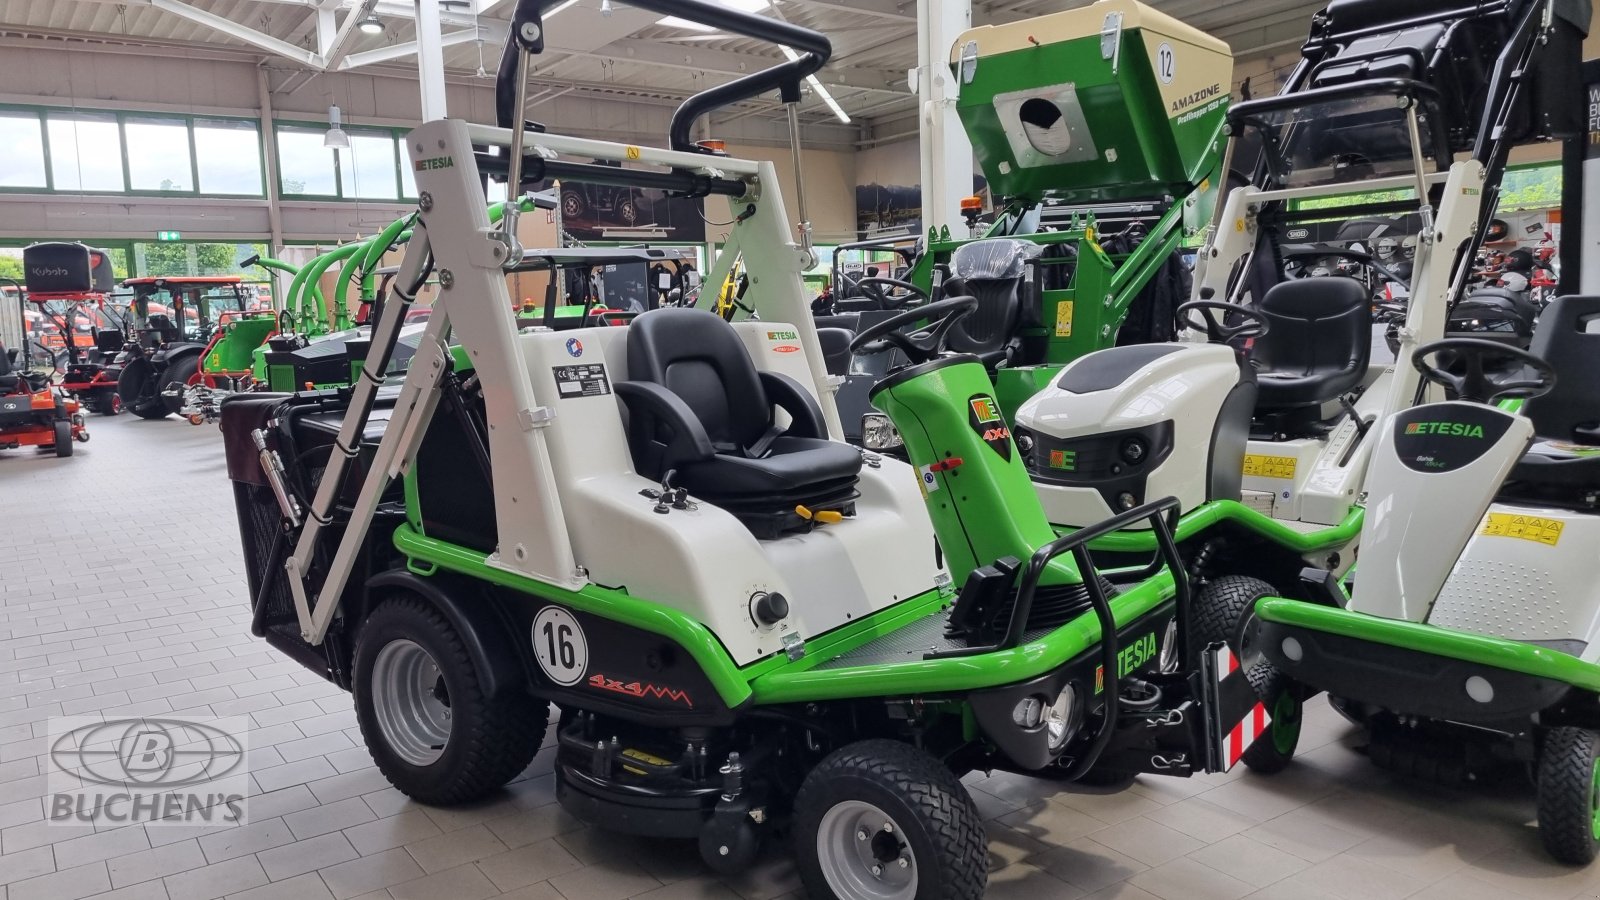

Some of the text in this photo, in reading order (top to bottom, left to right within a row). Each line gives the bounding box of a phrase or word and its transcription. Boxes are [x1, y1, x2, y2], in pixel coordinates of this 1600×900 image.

[1160, 49, 1172, 77] 12
[1171, 83, 1220, 112] AMAZONE
[416, 155, 454, 171] ETESIA
[32, 267, 69, 276] Kubota
[769, 331, 797, 340] ETESIA
[1407, 422, 1483, 438] ETESIA
[543, 621, 575, 670] 16
[1114, 632, 1157, 681] TESIA
